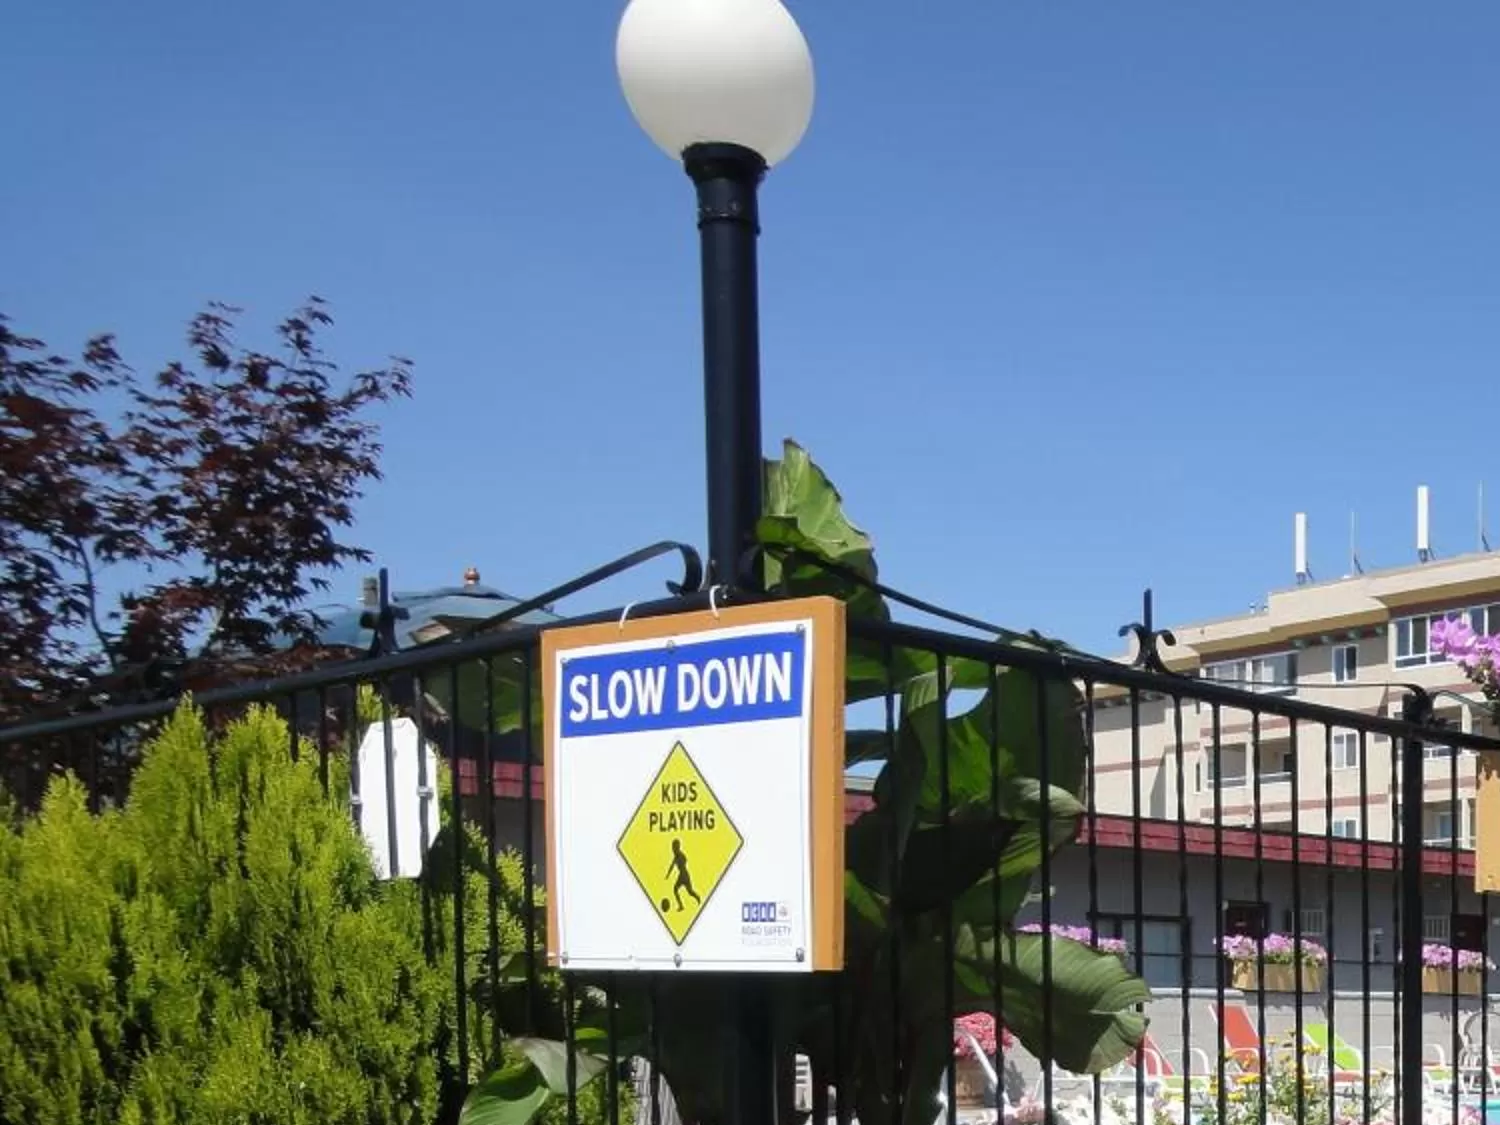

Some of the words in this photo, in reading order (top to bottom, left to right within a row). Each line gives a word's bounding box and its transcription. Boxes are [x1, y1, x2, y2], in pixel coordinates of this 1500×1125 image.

[569, 665, 665, 722] SLOW
[677, 651, 792, 713] DOWN
[661, 781, 698, 804] KIDS
[649, 810, 715, 832] PLAYING
